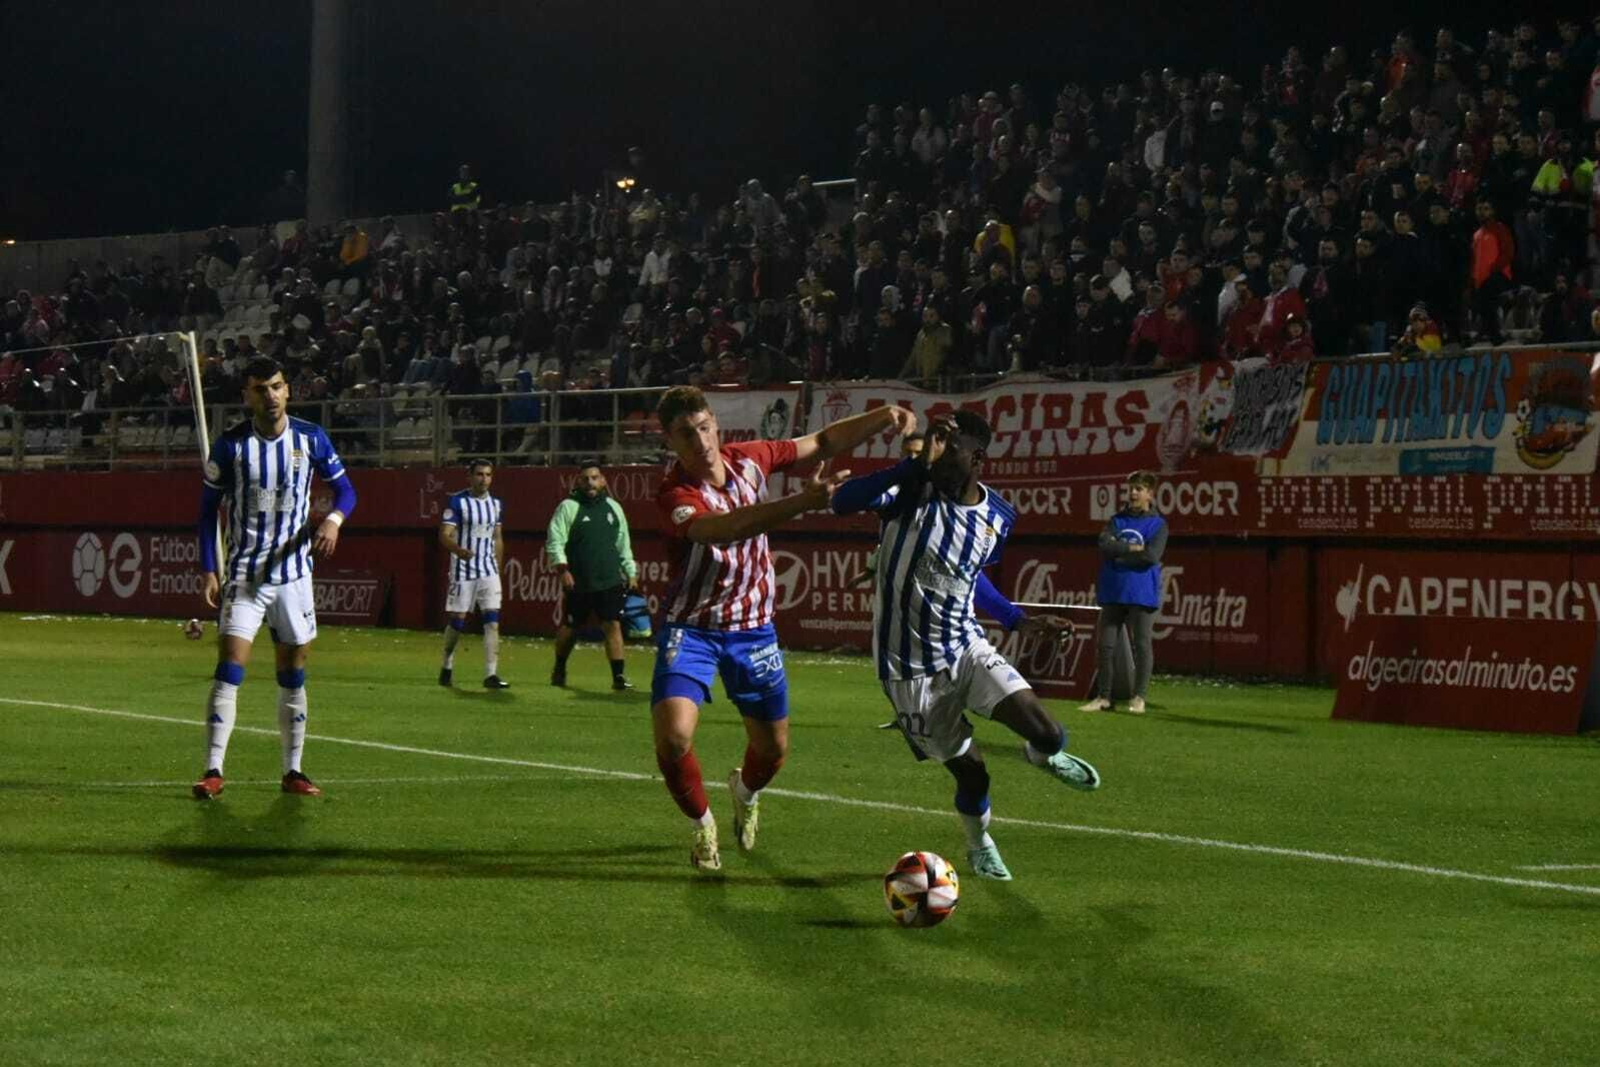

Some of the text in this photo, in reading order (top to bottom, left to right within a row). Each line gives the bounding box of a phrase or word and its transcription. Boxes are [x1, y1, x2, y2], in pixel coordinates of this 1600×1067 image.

[996, 484, 1073, 516] OCCER
[150, 535, 200, 562] Fútbol
[1348, 640, 1578, 693] algecirasalminuto.es
